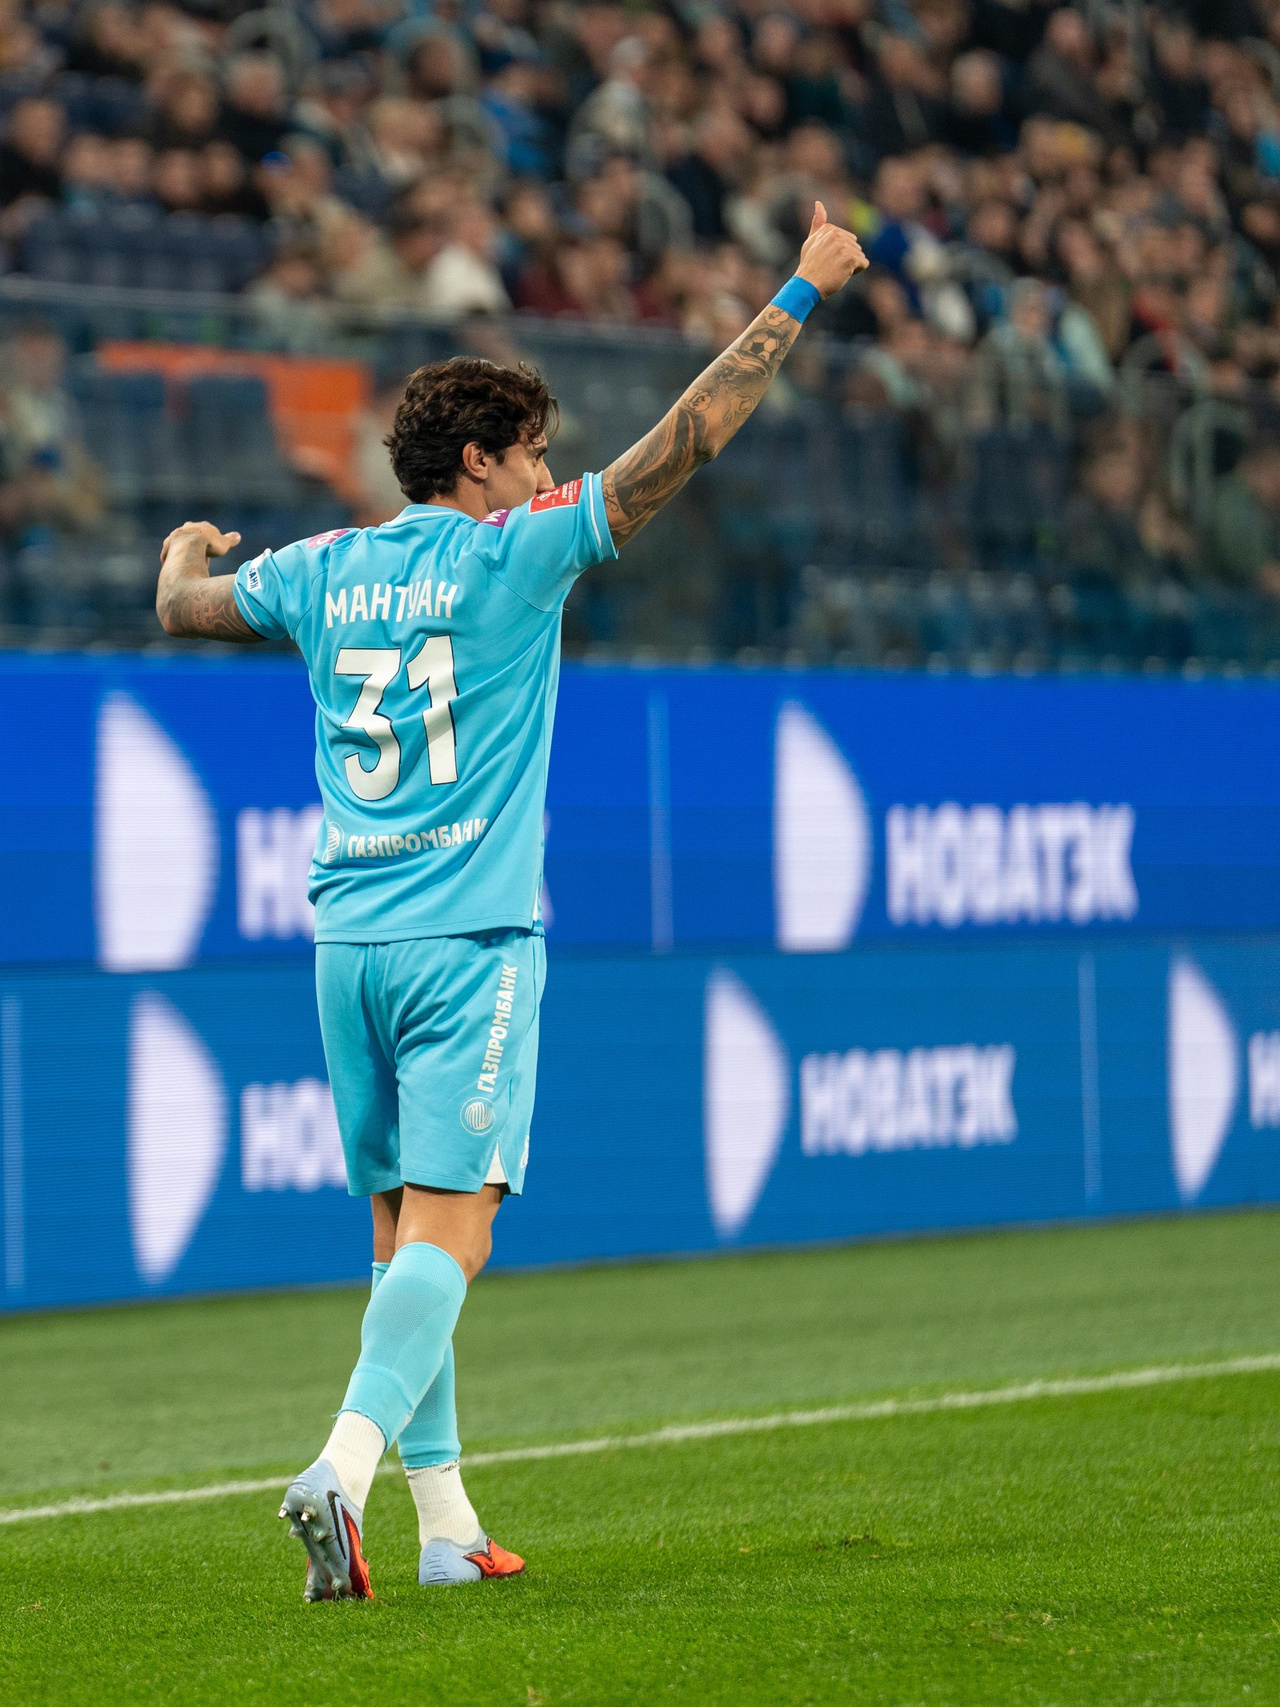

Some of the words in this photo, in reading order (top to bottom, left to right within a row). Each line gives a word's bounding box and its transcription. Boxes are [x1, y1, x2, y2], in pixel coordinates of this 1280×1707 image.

[325, 579, 459, 628] МАНТУАН
[334, 635, 458, 801] 31
[347, 818, 488, 858] ГАЗПРОМБАНК
[886, 803, 1136, 924] НОВАТЭК
[477, 964, 518, 1093] ГАЗПРОМБАНК
[800, 1043, 1017, 1155] НОВАТЭК
